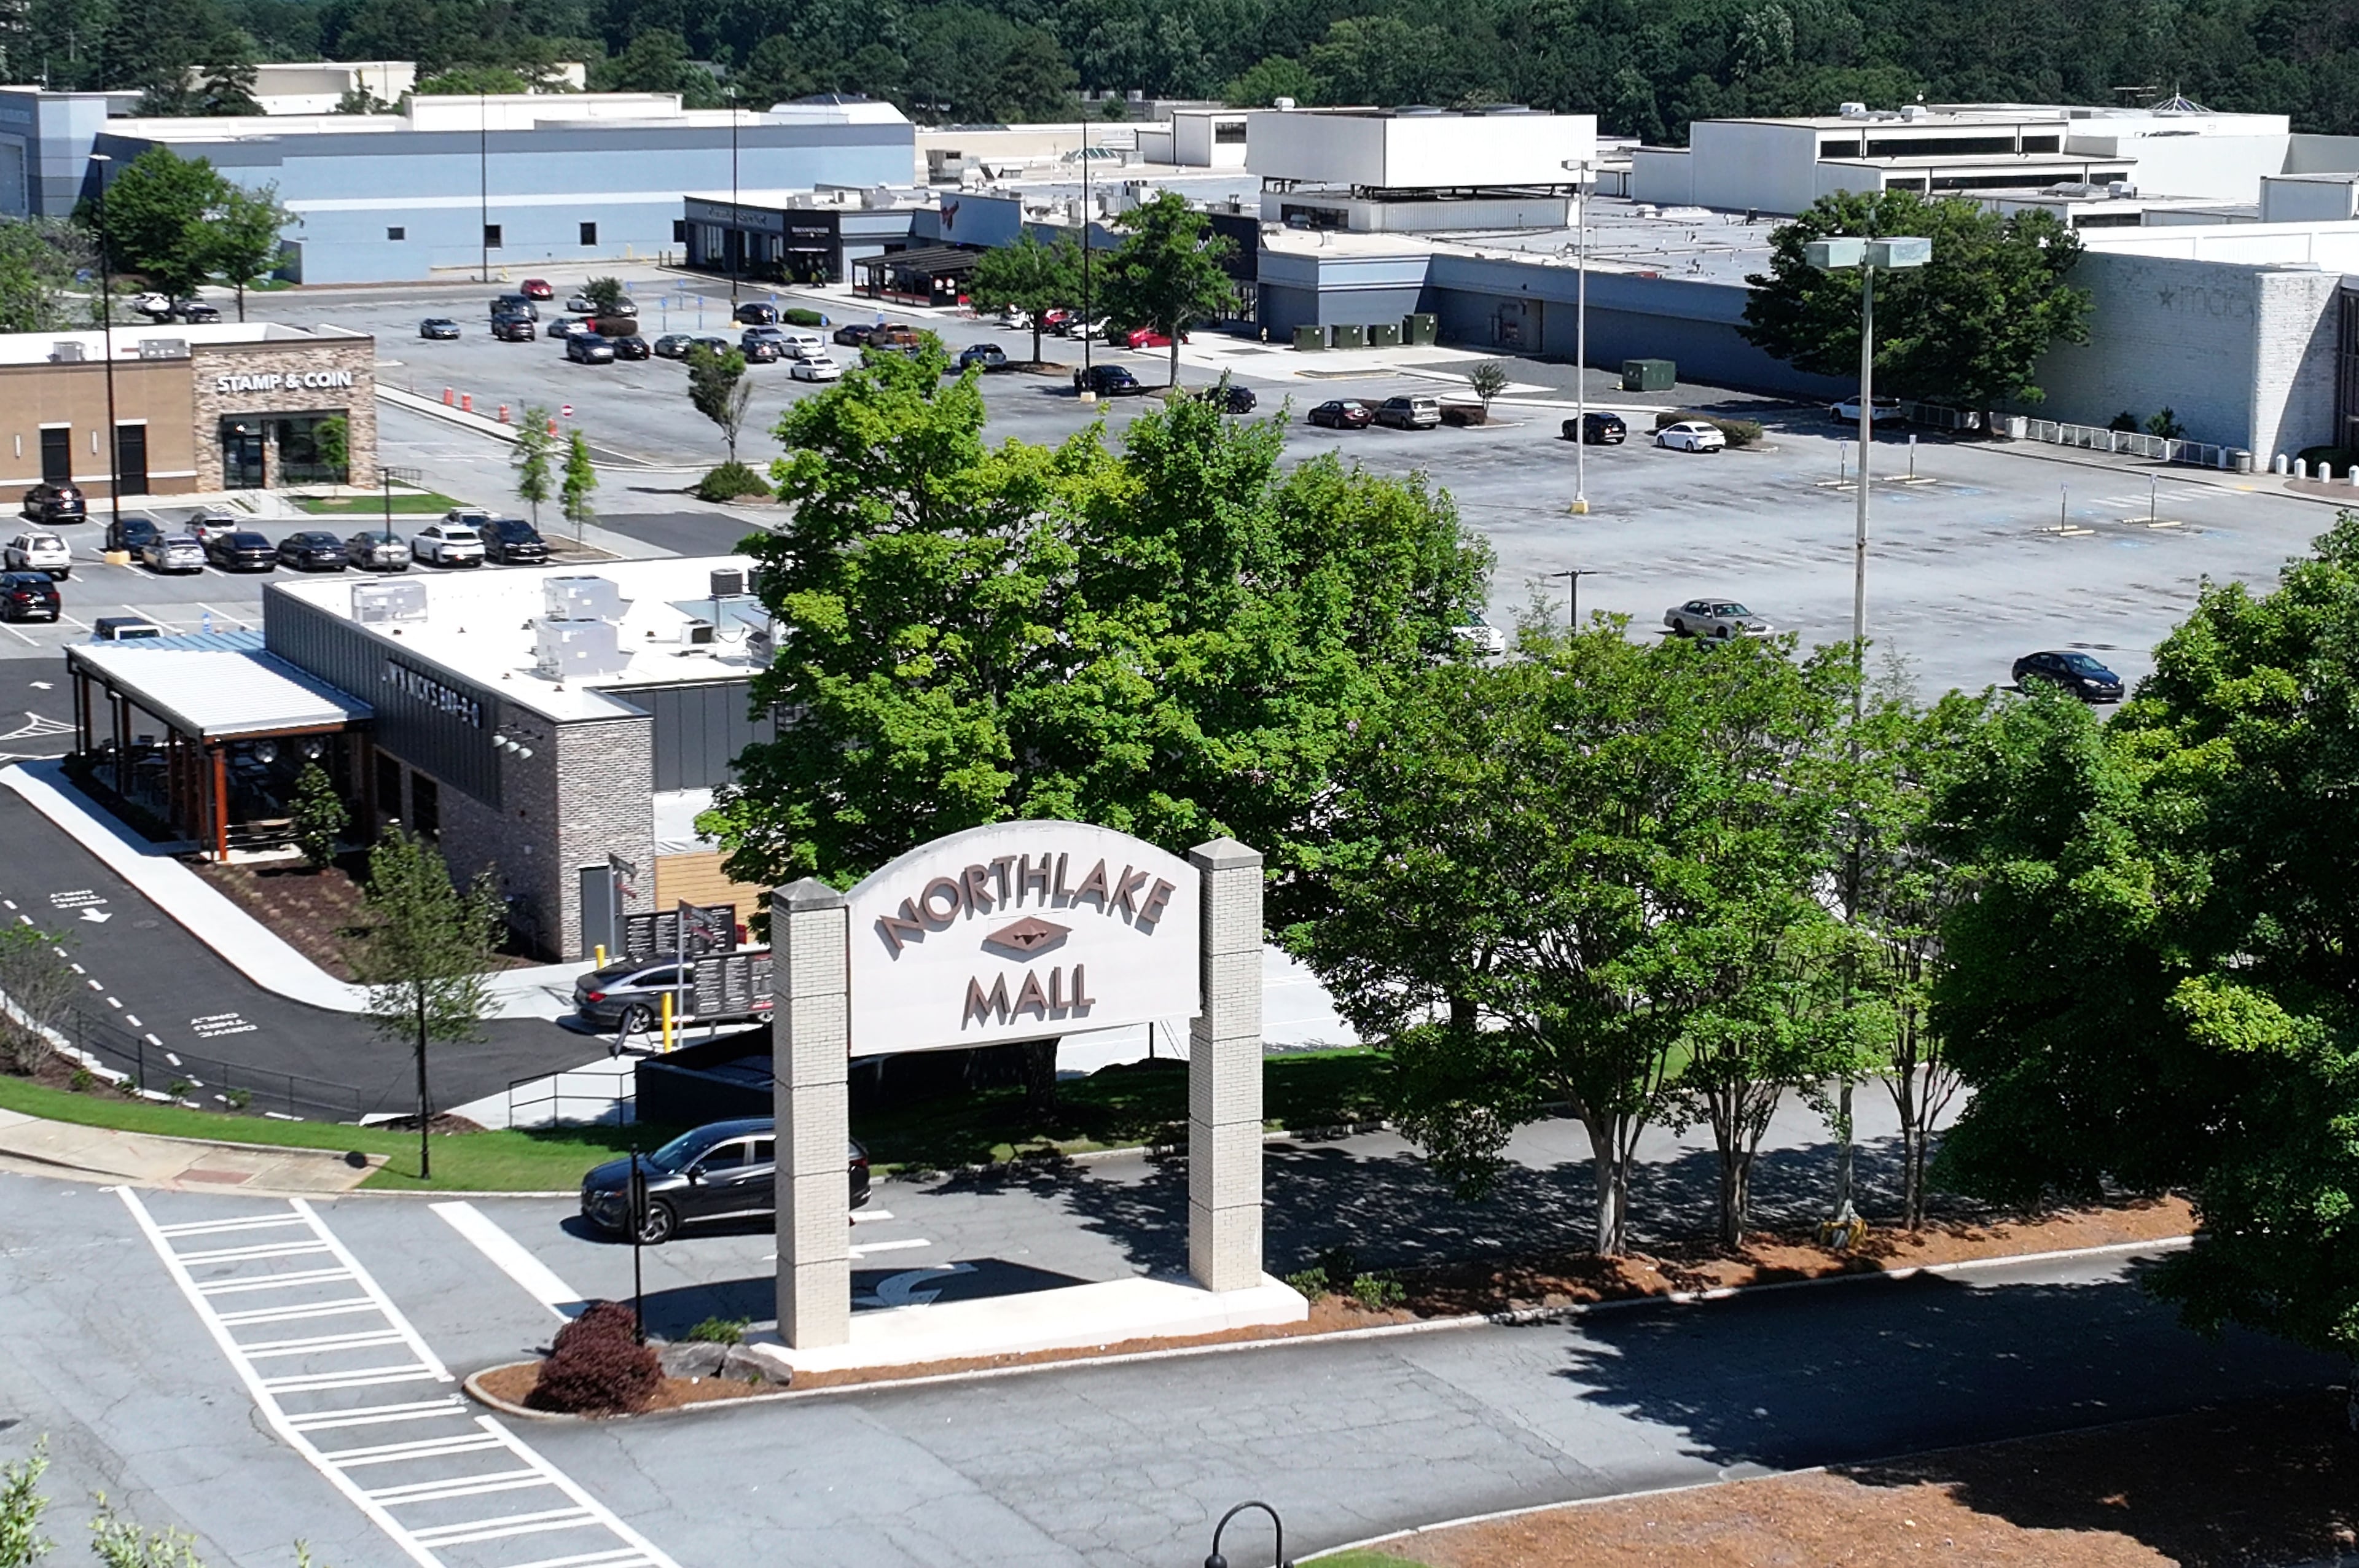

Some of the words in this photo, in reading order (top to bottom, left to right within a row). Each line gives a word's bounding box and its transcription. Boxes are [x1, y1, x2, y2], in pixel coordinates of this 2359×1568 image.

[217, 375, 281, 392] STAMP
[285, 373, 300, 389] &
[304, 371, 353, 388] COIN
[877, 852, 1176, 953] NORTHLAKE
[963, 963, 1096, 1024] MALL
